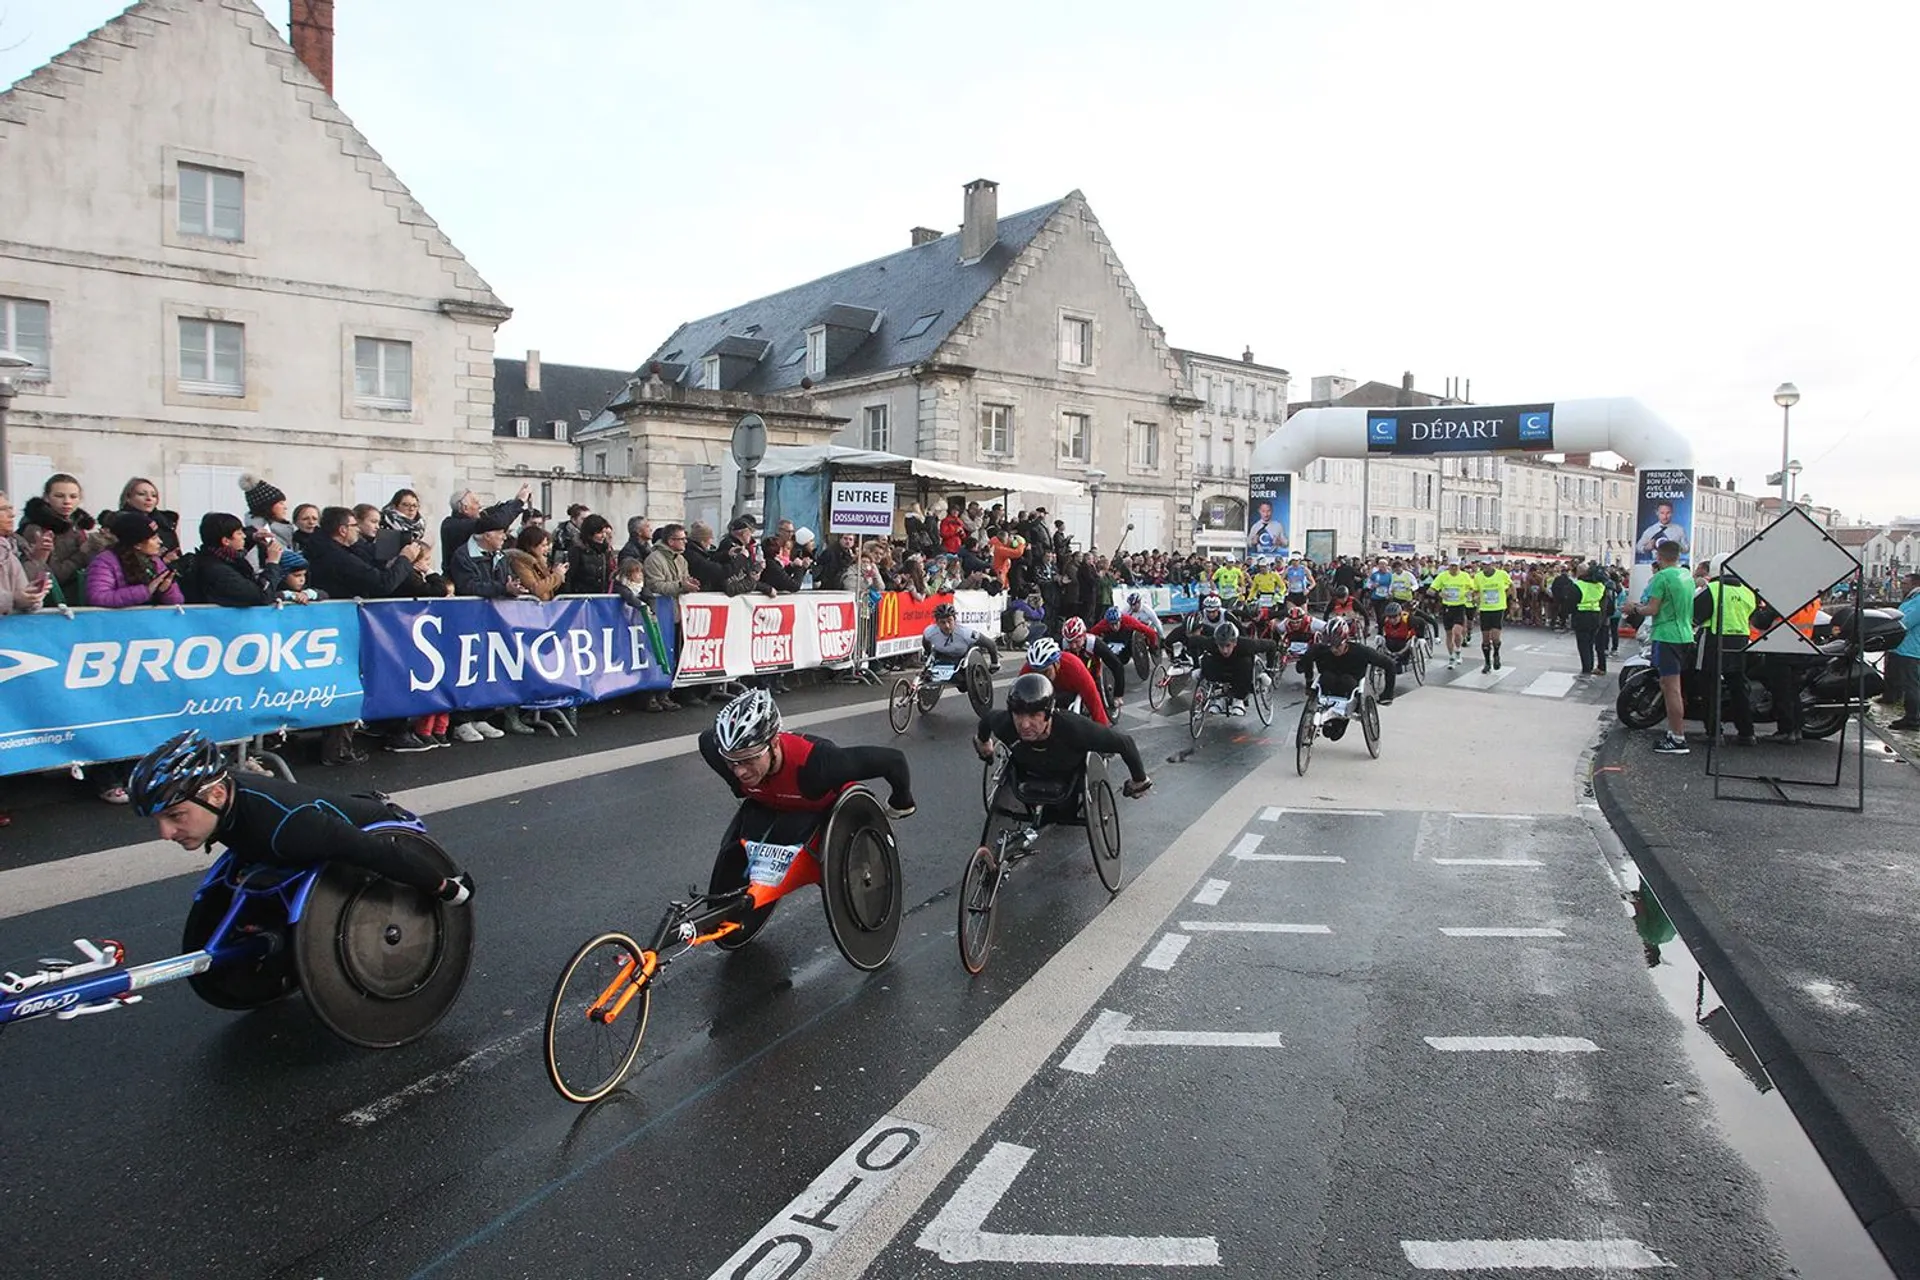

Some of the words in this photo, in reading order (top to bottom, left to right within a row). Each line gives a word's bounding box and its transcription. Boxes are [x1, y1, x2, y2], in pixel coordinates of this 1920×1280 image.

[1411, 418, 1503, 440] DÉPART
[837, 490, 888, 503] ENTREE
[1645, 491, 1685, 499] CIPECMA
[834, 513, 864, 523] DOSSARD
[865, 514, 889, 523] VIOLET
[754, 606, 783, 634] SUD
[818, 605, 842, 630] SUD
[410, 614, 649, 692] SENOBLE
[753, 633, 792, 663] OUEST
[820, 629, 855, 657] OUEST
[64, 628, 340, 689] BROOKS
[180, 697, 243, 716] run
[251, 683, 338, 712] happy
